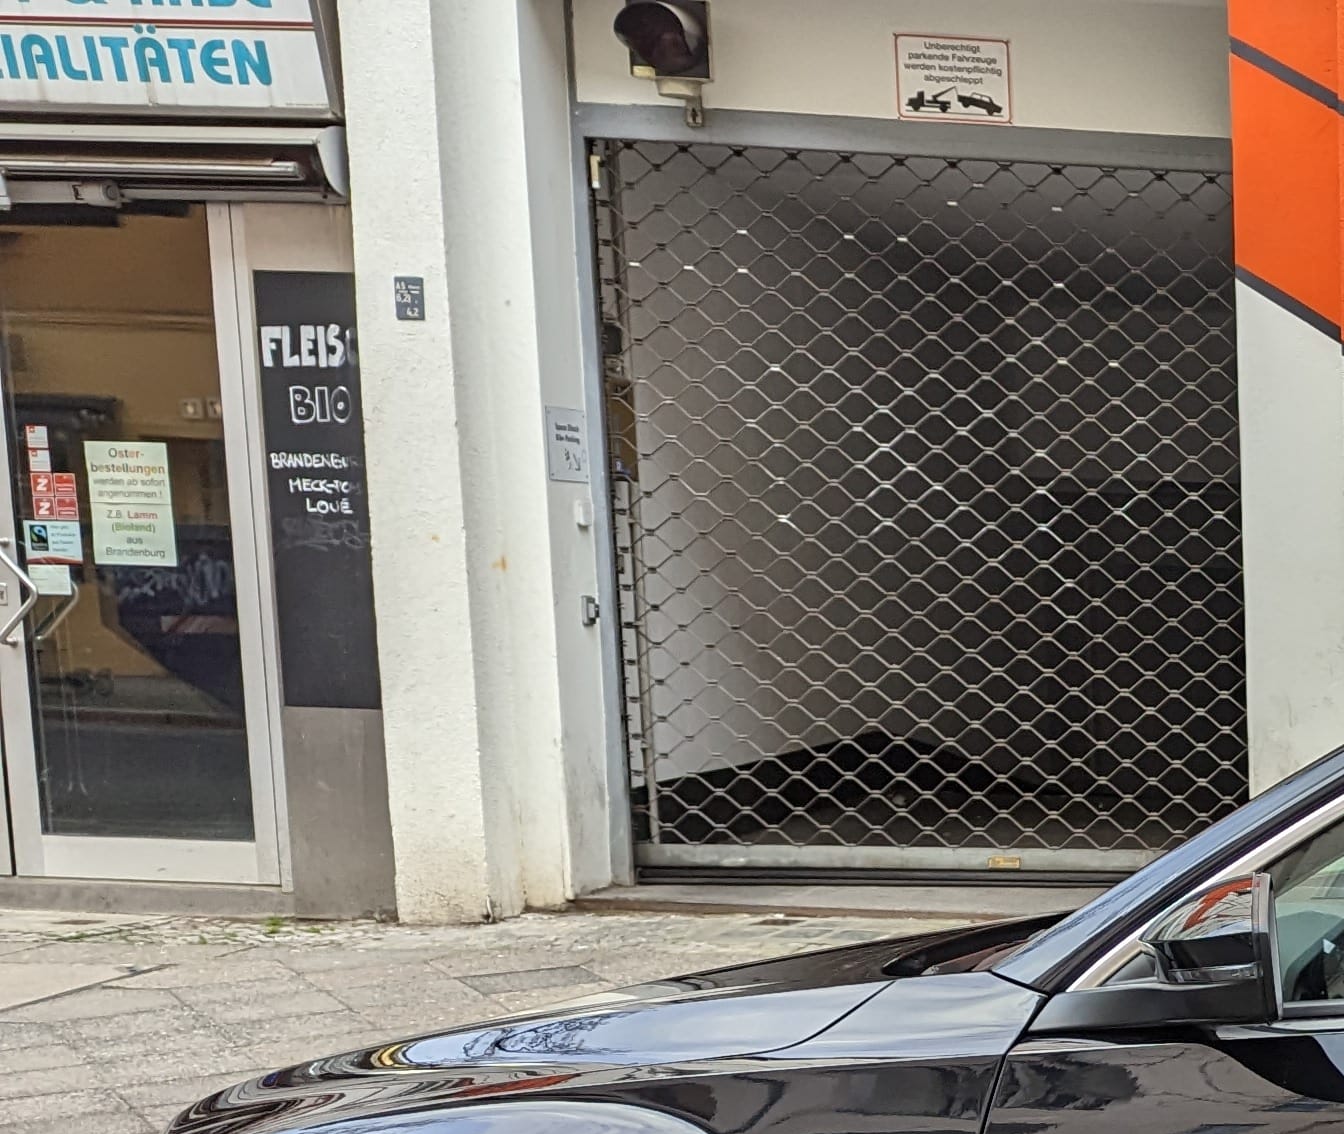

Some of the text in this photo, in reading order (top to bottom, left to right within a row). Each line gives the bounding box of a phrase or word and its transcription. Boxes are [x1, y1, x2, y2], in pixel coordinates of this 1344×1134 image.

[924, 41, 980, 54] Unberechtigt
[0, 24, 272, 86] IALITÄTEN
[908, 52, 997, 66] parkende Fahrzeuge
[904, 63, 1002, 77] werden kostenpflichtig
[924, 74, 984, 85] abgeschleppt
[260, 324, 351, 367] FLEIS
[288, 385, 352, 424] BIO
[108, 448, 144, 459] Oster-
[90, 462, 165, 475] bestellungen
